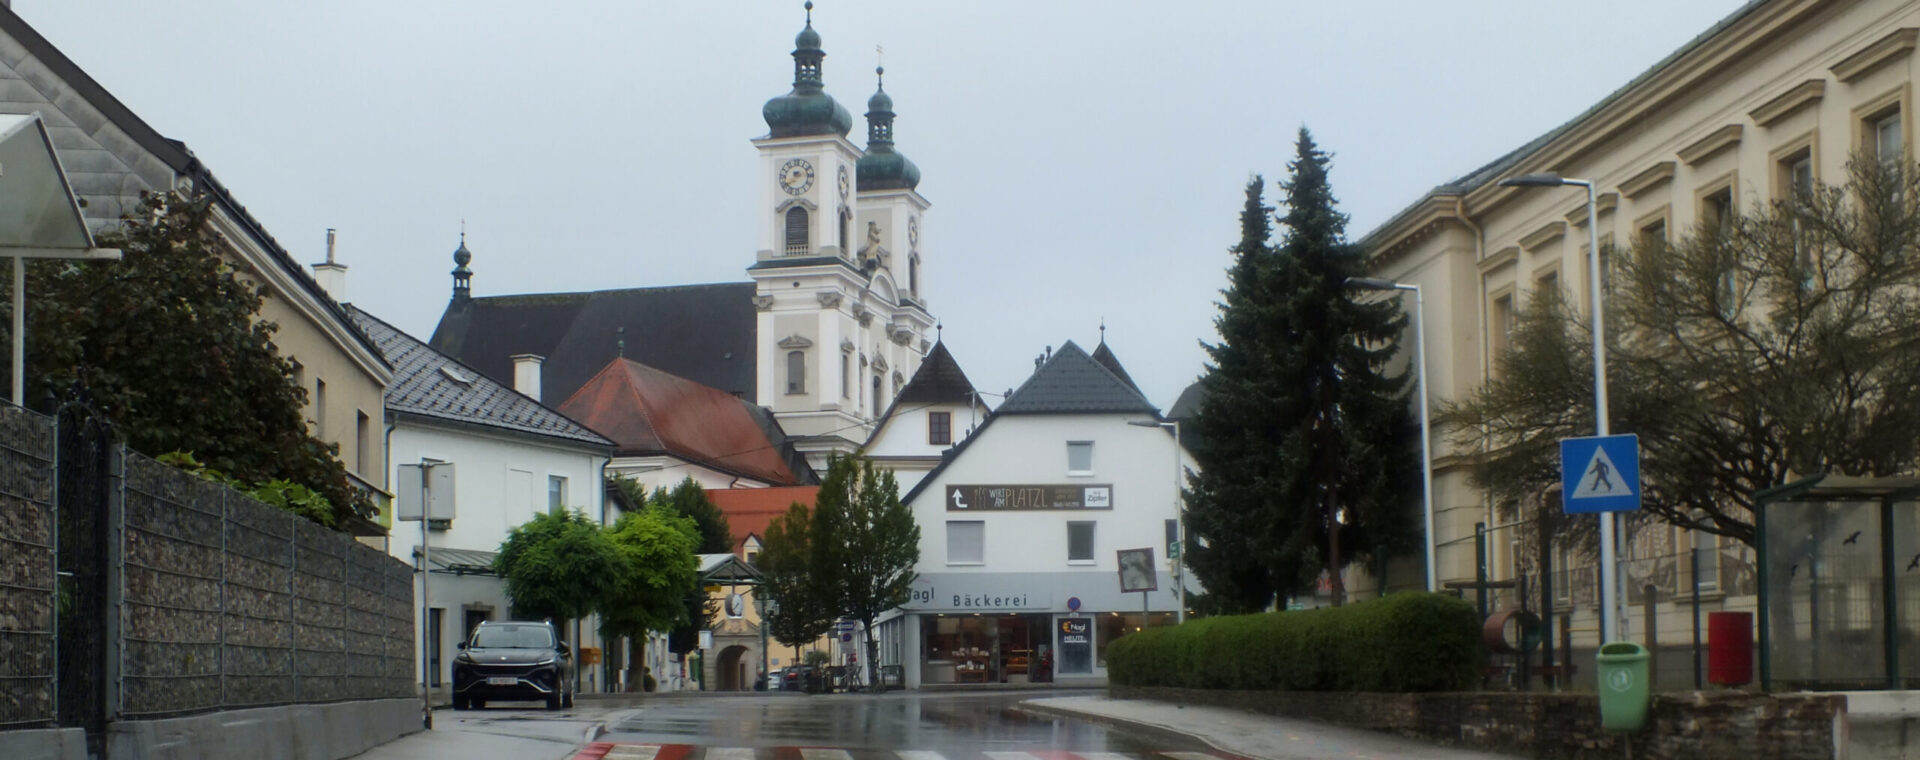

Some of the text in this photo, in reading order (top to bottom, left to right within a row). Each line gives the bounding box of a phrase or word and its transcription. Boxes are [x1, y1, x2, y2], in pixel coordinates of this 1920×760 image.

[994, 497, 1005, 508] AM
[1005, 487, 1048, 508] PLATZL
[953, 594, 1027, 607] Bäckerei
